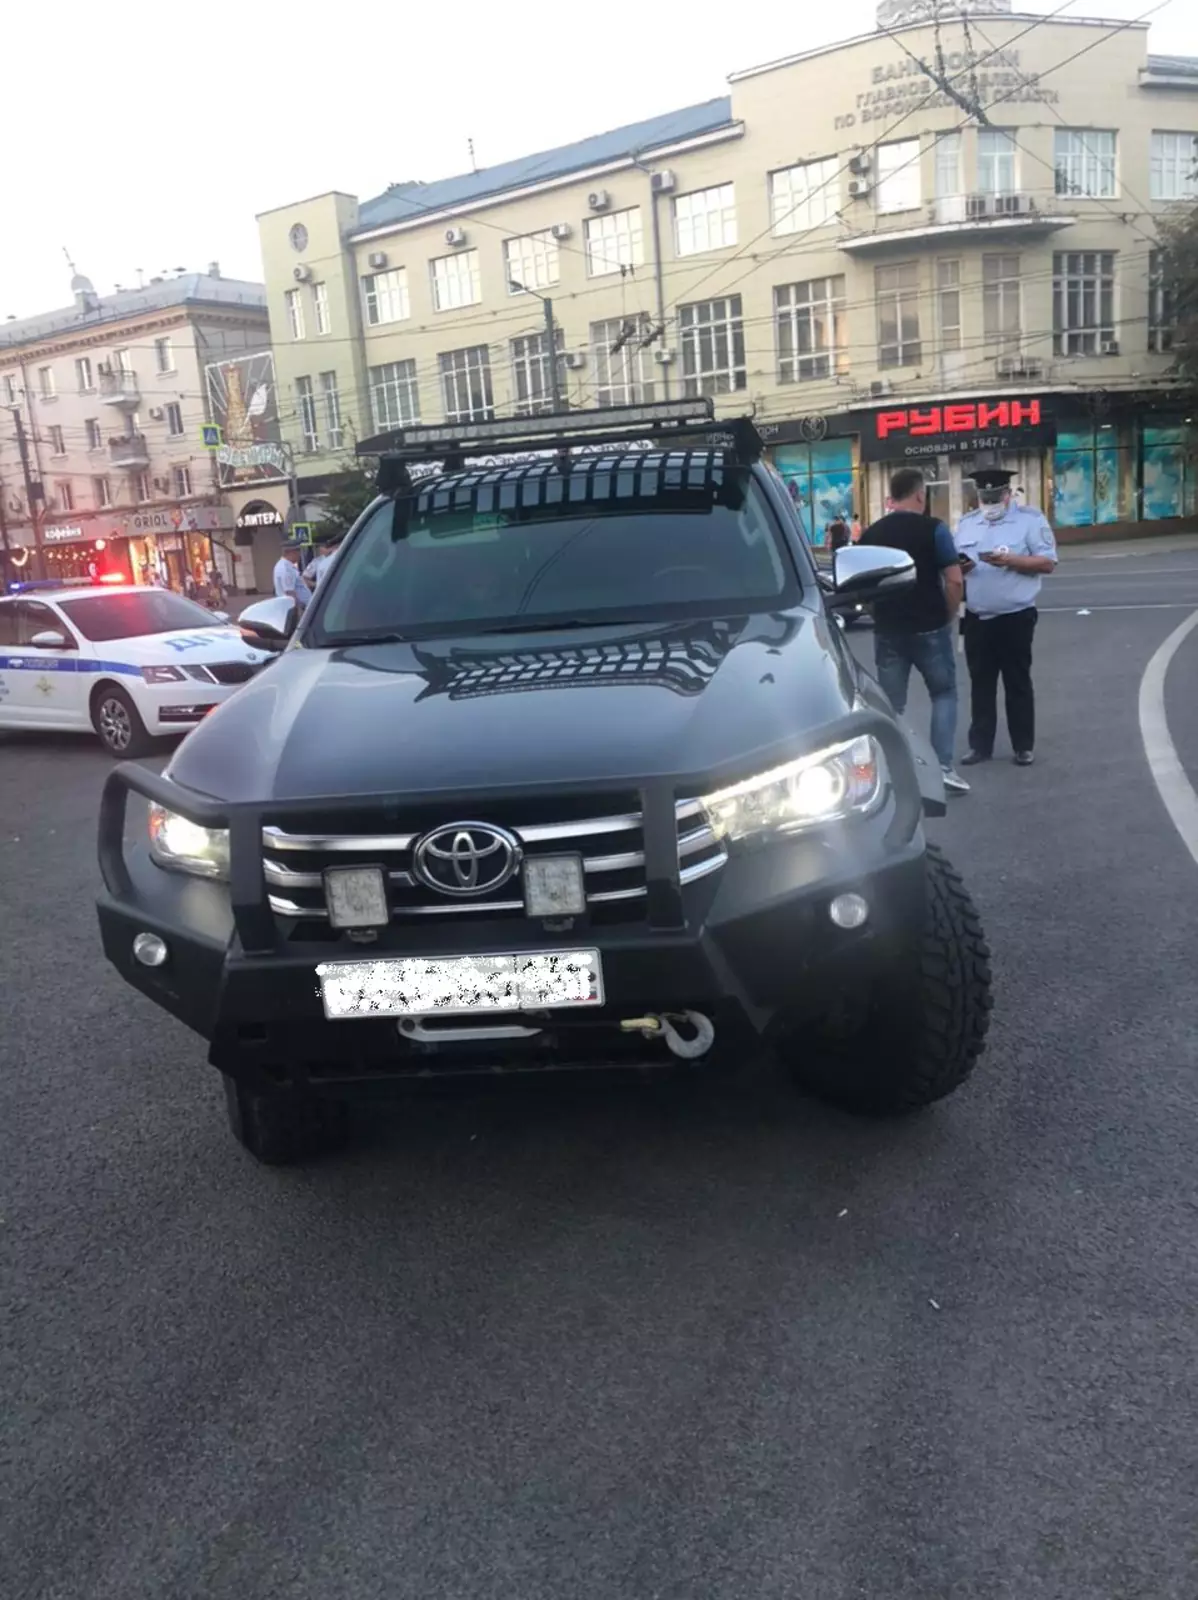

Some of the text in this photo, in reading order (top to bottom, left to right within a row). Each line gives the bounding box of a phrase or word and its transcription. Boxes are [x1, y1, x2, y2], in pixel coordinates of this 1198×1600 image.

[834, 112, 856, 131] ПО
[876, 399, 1041, 440] РУБИН
[972, 436, 999, 449] 1947
[244, 511, 283, 528] ЛИТЕРА
